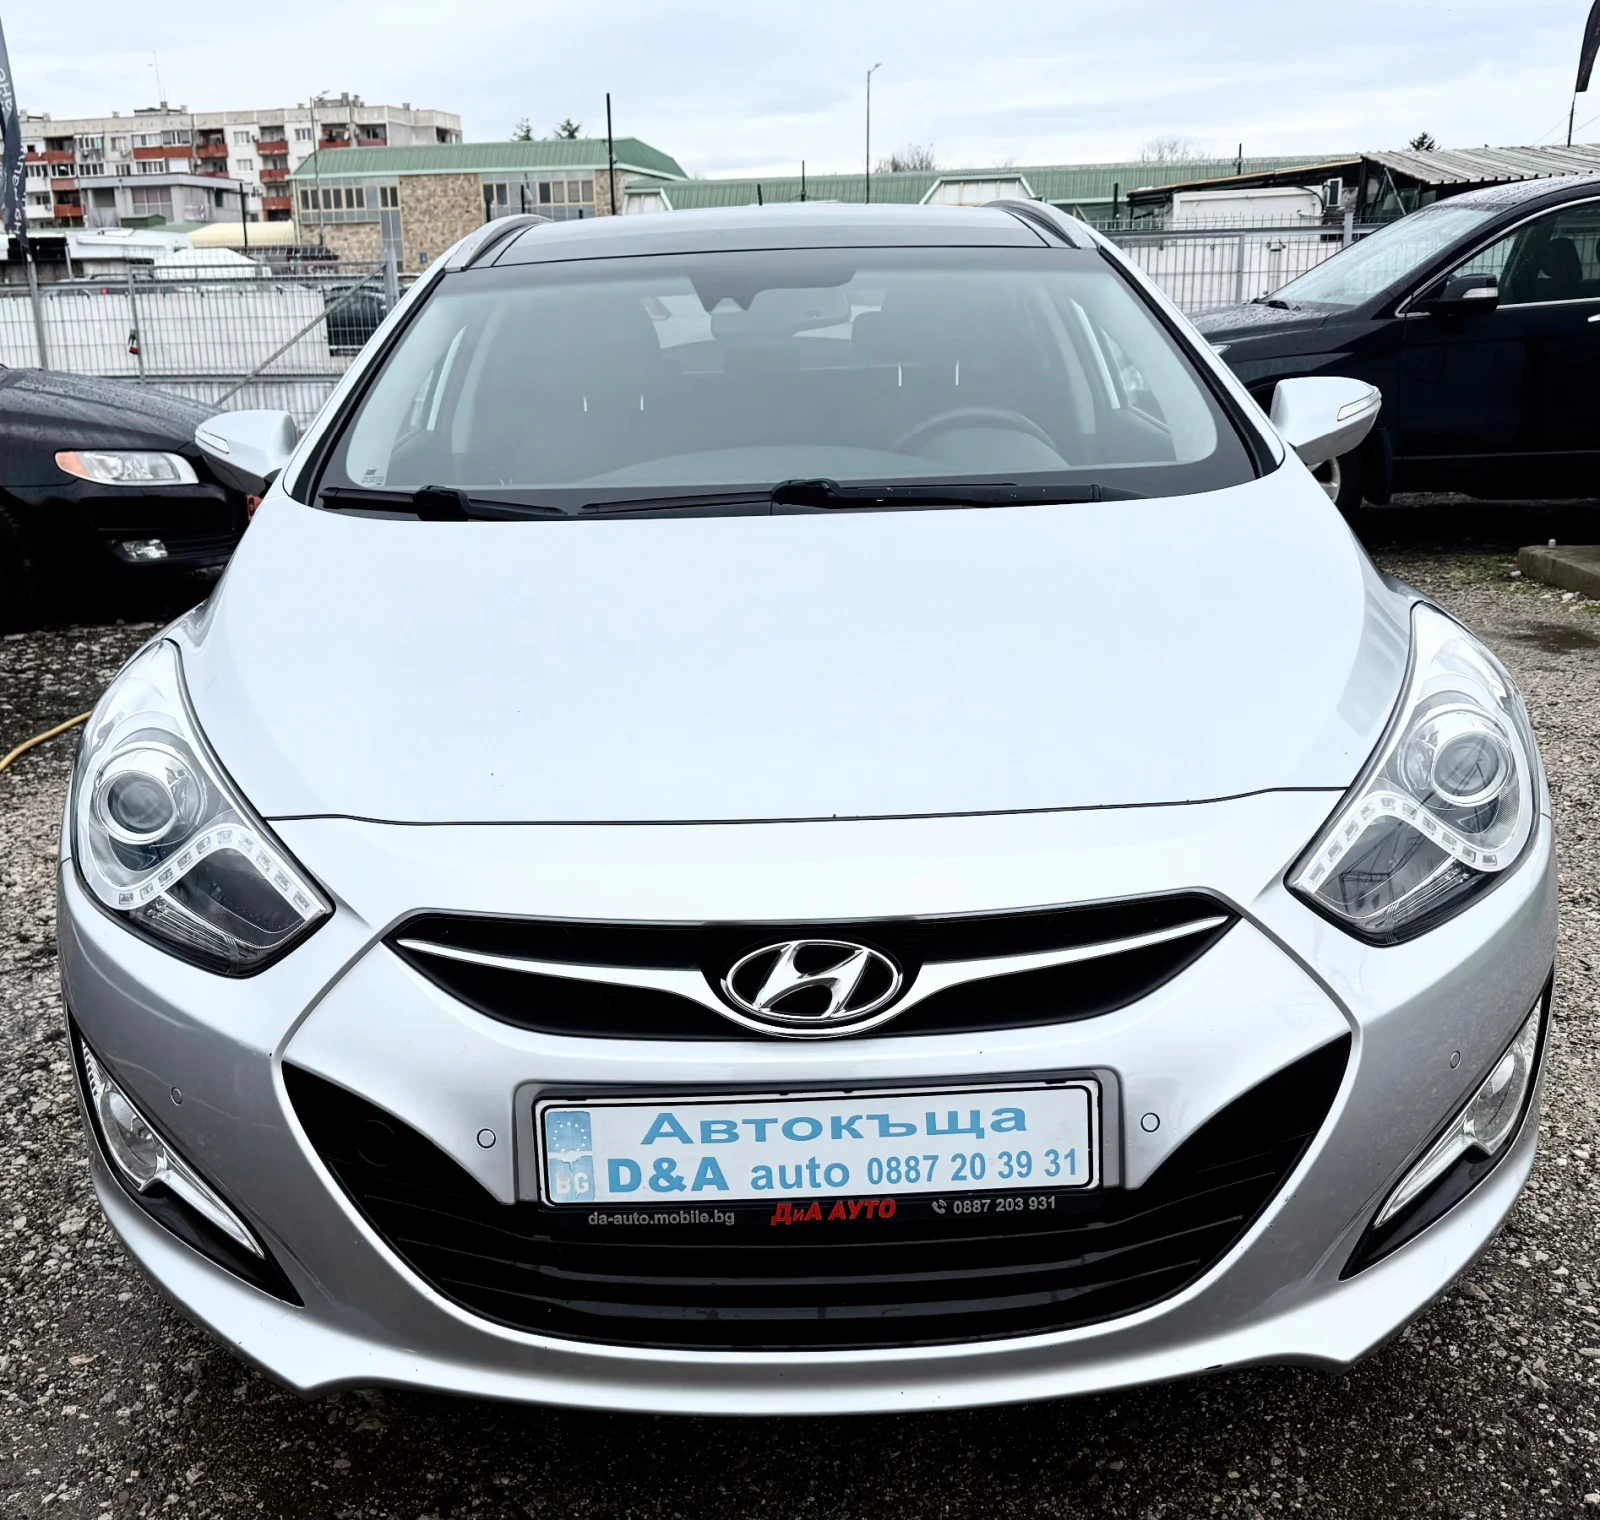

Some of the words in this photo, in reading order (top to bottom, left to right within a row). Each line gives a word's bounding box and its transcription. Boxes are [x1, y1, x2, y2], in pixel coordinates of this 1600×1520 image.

[640, 1107, 1027, 1145] Автокъща
[607, 1156, 730, 1193] D&A
[750, 1156, 850, 1191] auto
[867, 1154, 939, 1185] 0887
[950, 1152, 986, 1182] 20
[997, 1150, 1033, 1179] 39
[1044, 1147, 1077, 1177] 31
[555, 1172, 589, 1195] BG
[770, 1201, 822, 1226] ДиА
[953, 1199, 991, 1214] 0887
[995, 1197, 1024, 1212] 203
[1028, 1195, 1057, 1210] 931
[588, 1209, 736, 1226] da-auto.mobile.bg
